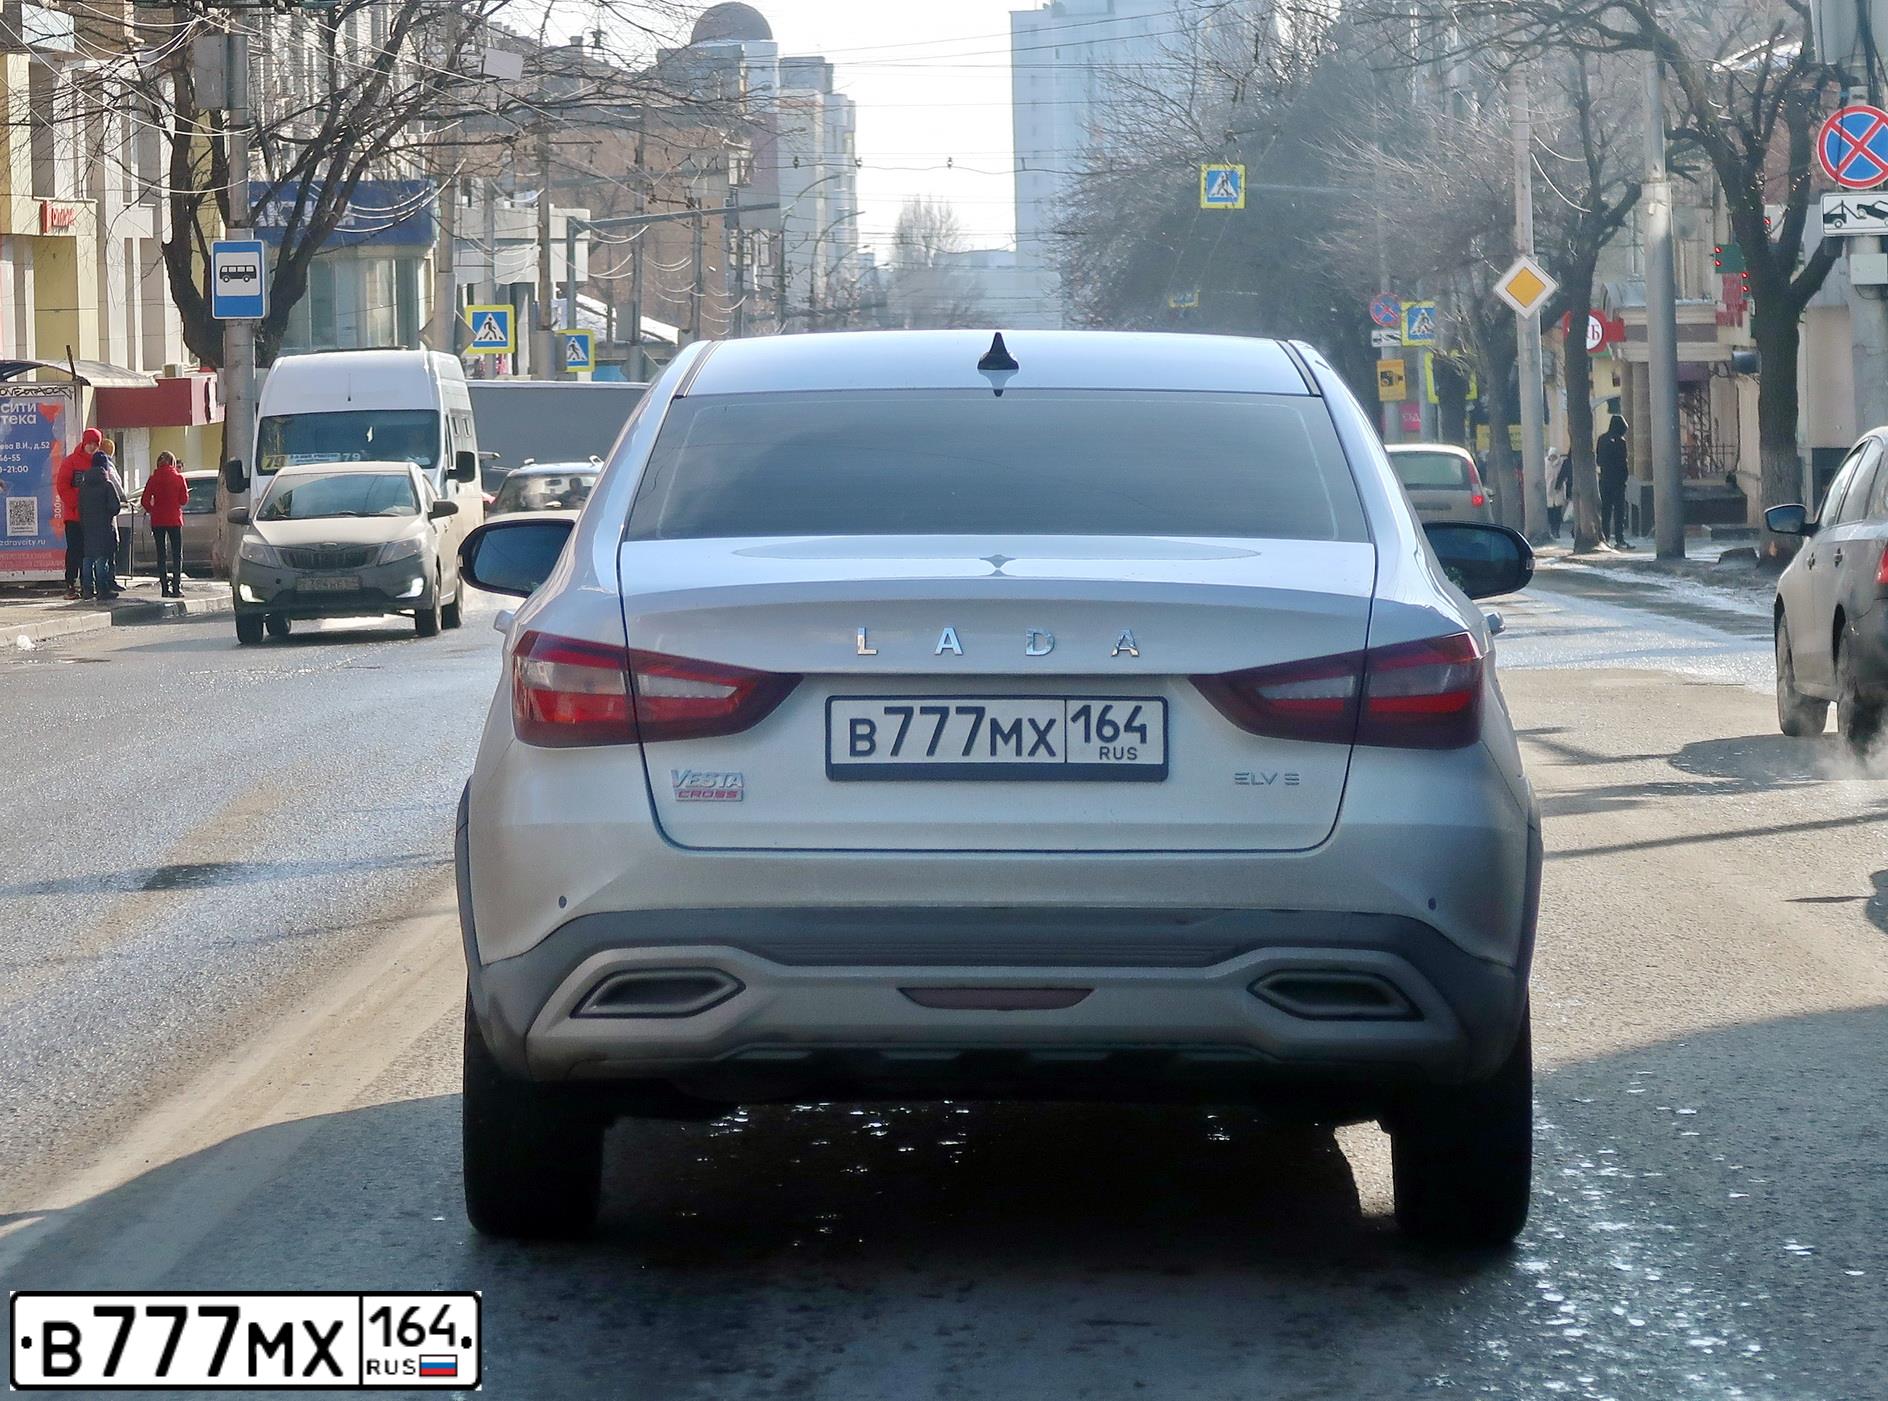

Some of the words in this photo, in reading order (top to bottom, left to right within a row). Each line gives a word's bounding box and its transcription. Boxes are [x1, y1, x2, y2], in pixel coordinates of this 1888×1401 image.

[1, 403, 37, 413] сити
[0, 414, 37, 425] тека
[33, 441, 50, 450] д.52
[856, 627, 1141, 658] LADA
[1070, 705, 1148, 744] 164
[1099, 747, 1138, 760] RUS
[671, 769, 744, 788] VESTA
[677, 790, 738, 799] CROSS
